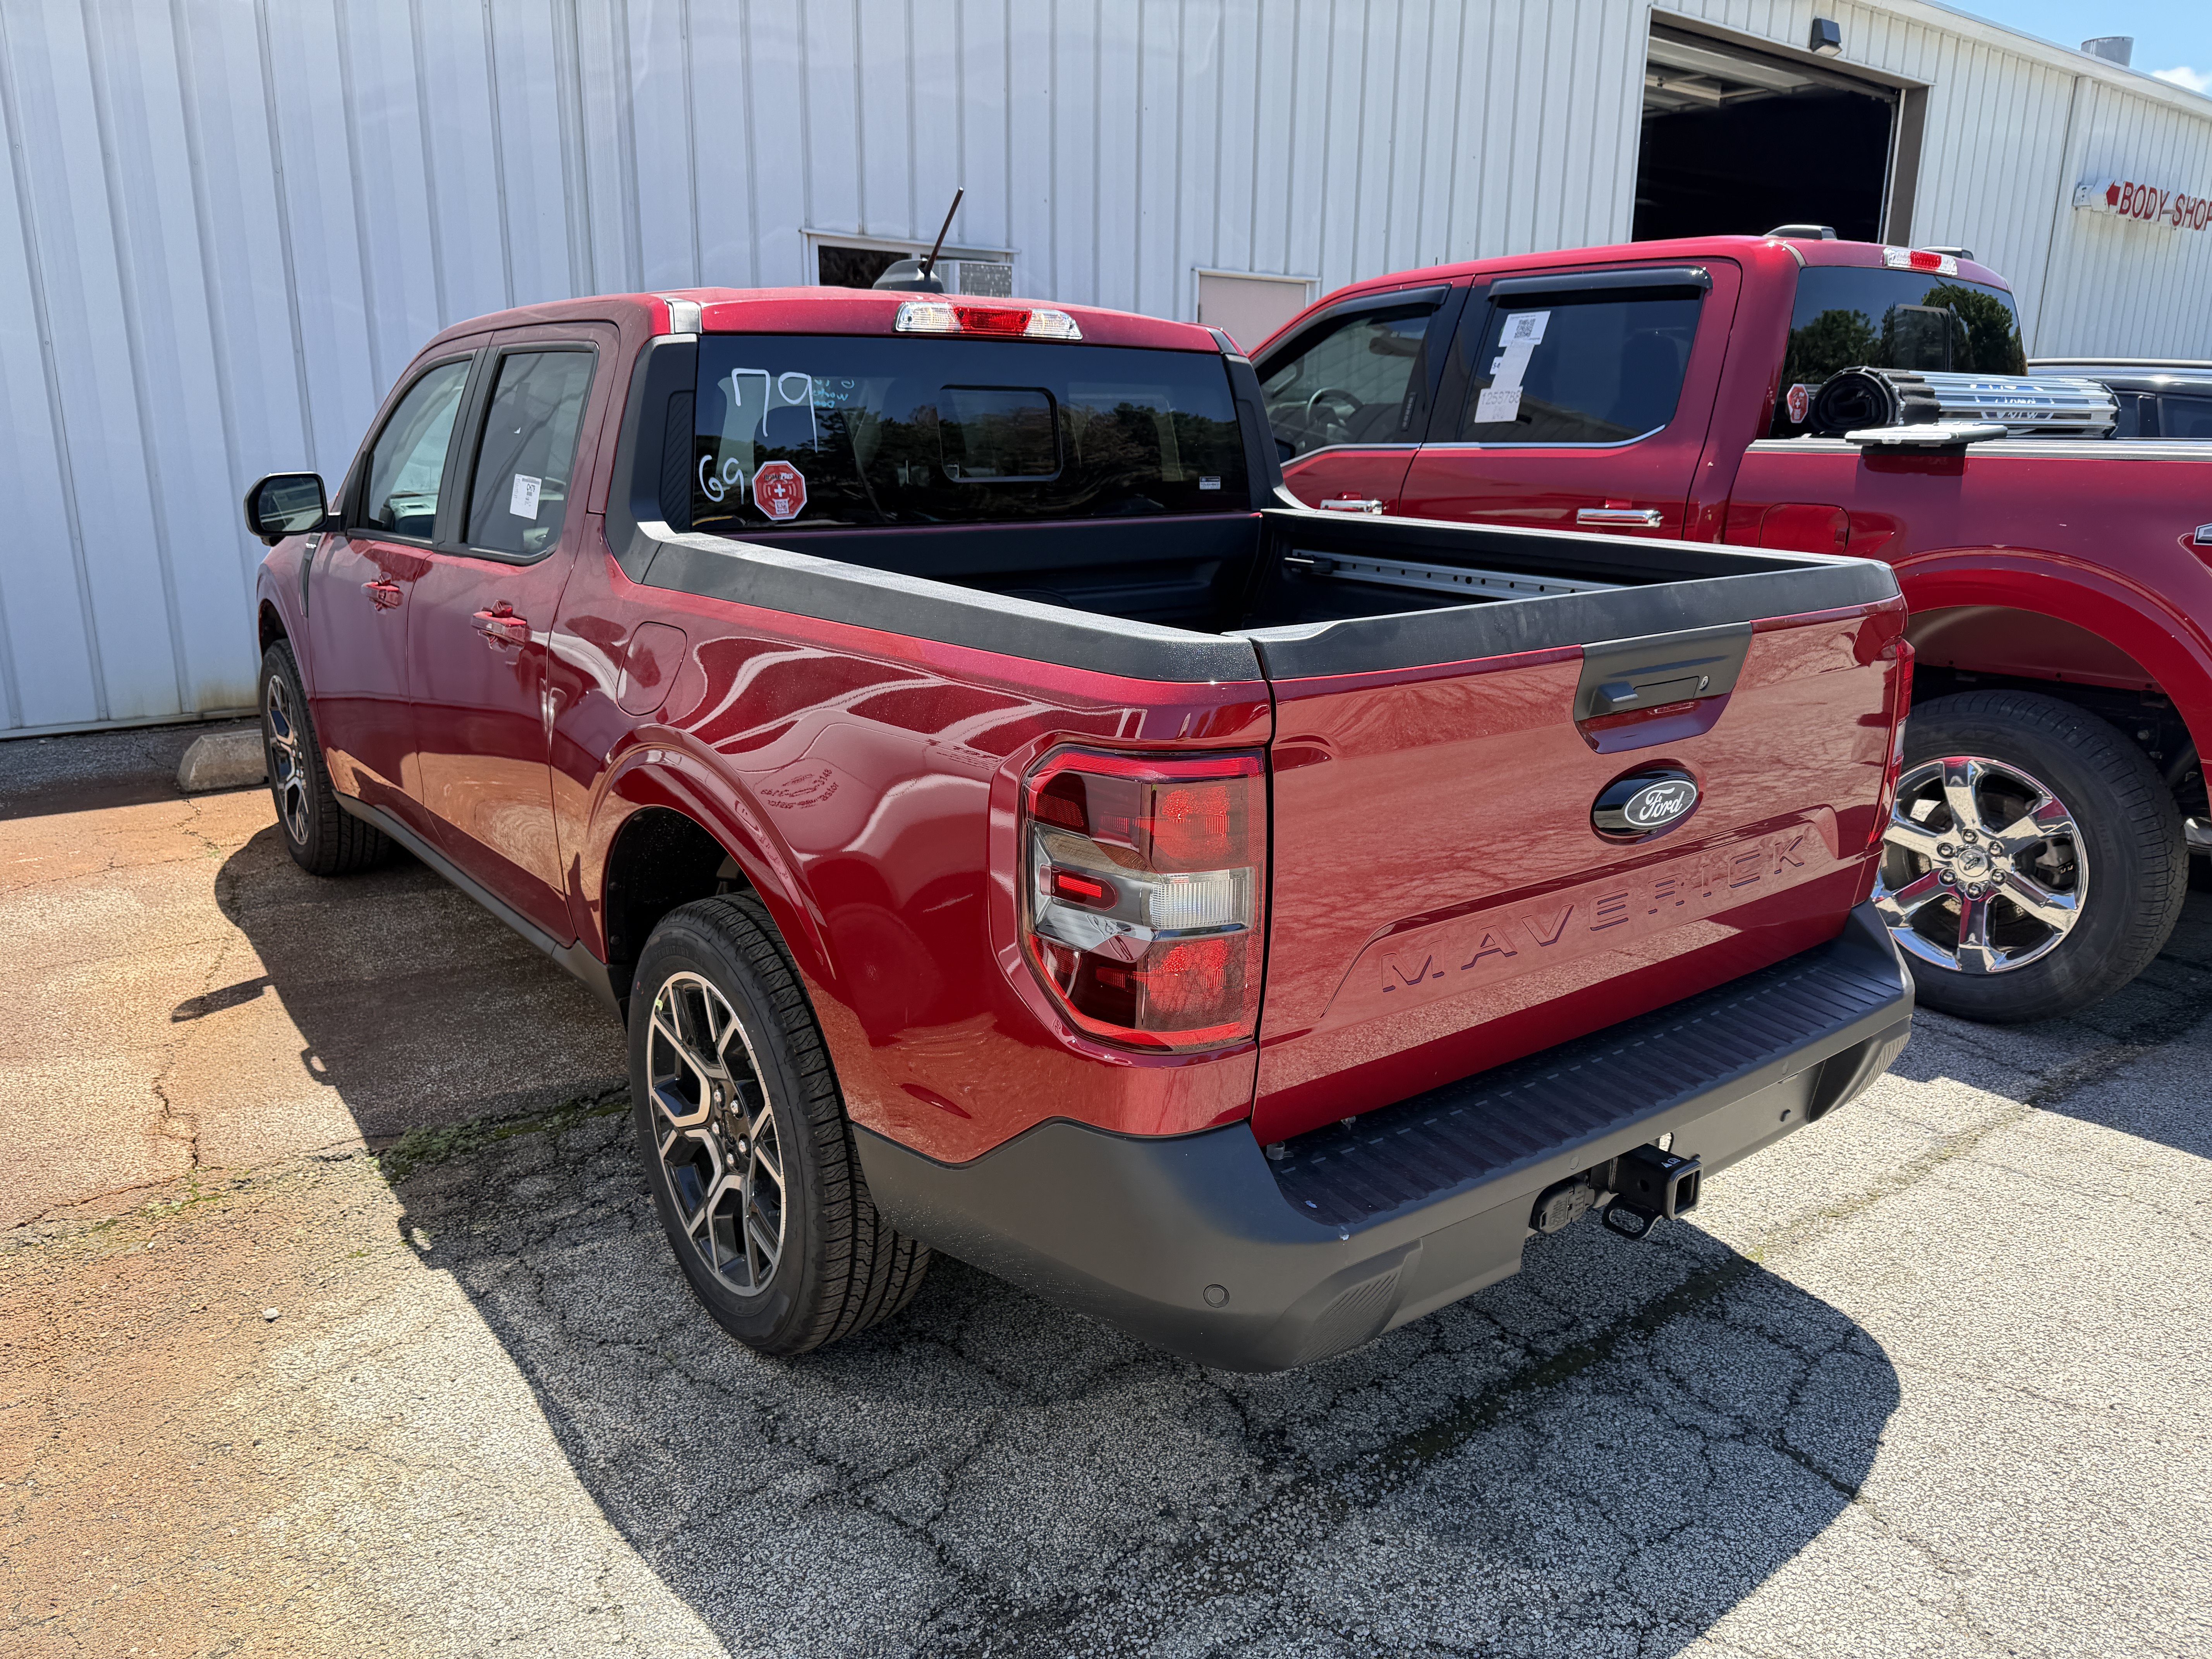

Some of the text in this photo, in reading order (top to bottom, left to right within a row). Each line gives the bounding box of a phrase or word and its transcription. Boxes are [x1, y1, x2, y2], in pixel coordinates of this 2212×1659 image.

[2119, 181, 2170, 222] BODY
[732, 368, 818, 453] 79
[699, 455, 745, 504] 69
[1639, 787, 1685, 820] Ford
[1380, 833, 1805, 994] MAVERICK
